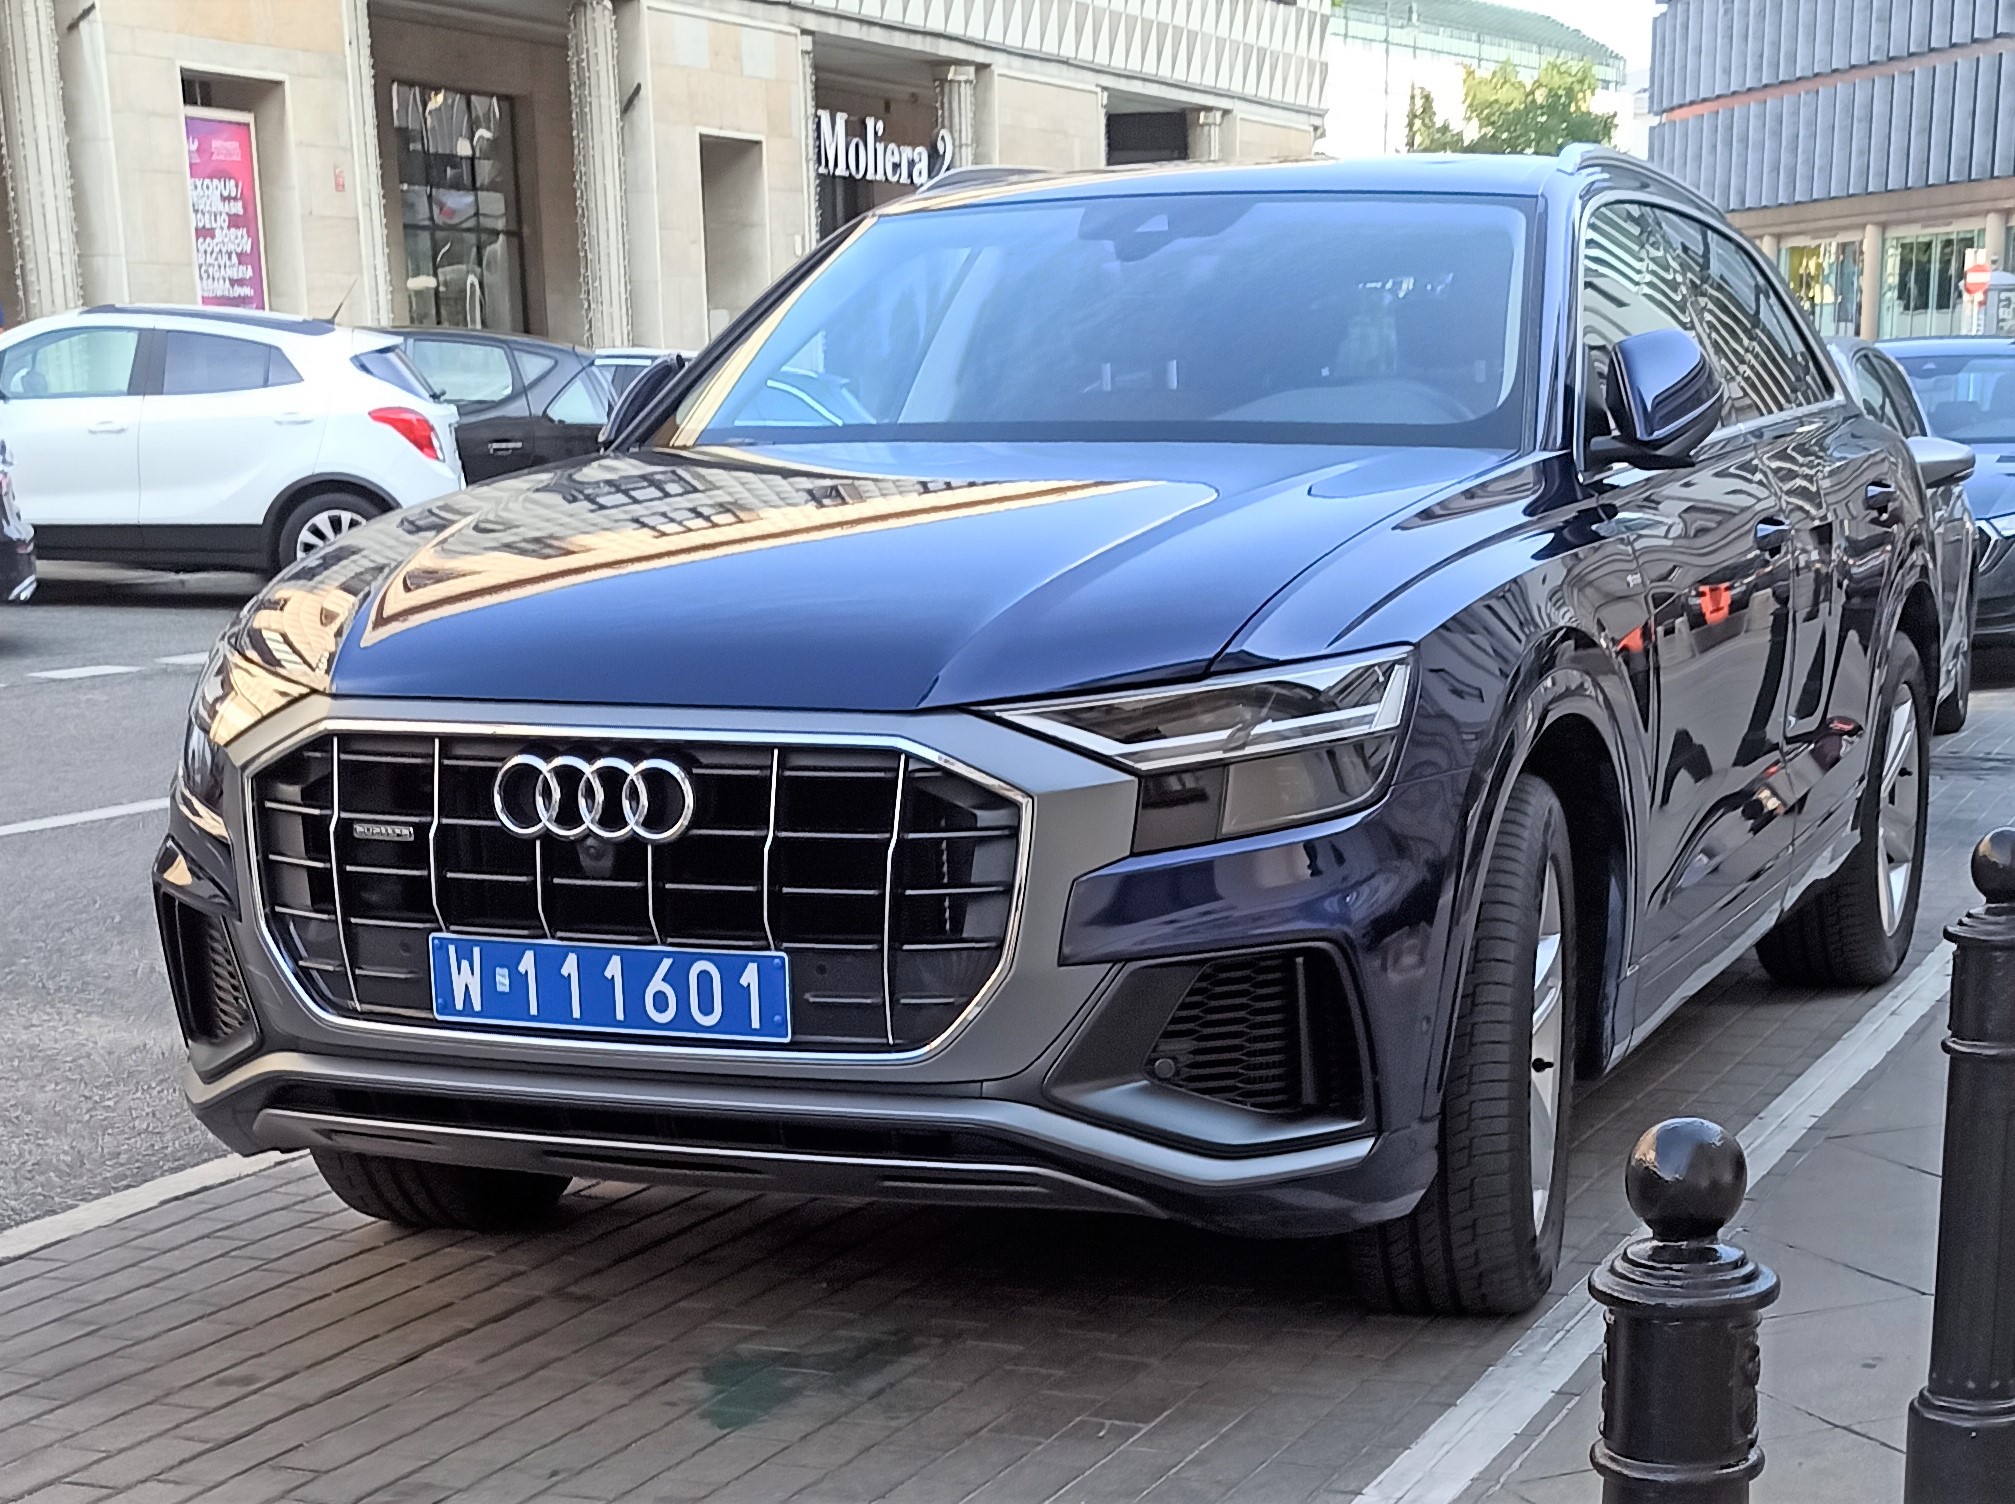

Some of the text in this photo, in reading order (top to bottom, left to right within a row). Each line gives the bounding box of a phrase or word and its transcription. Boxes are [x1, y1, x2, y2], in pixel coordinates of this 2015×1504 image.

[816, 109, 954, 187] Moliera 2
[448, 944, 761, 1030] W 111601
